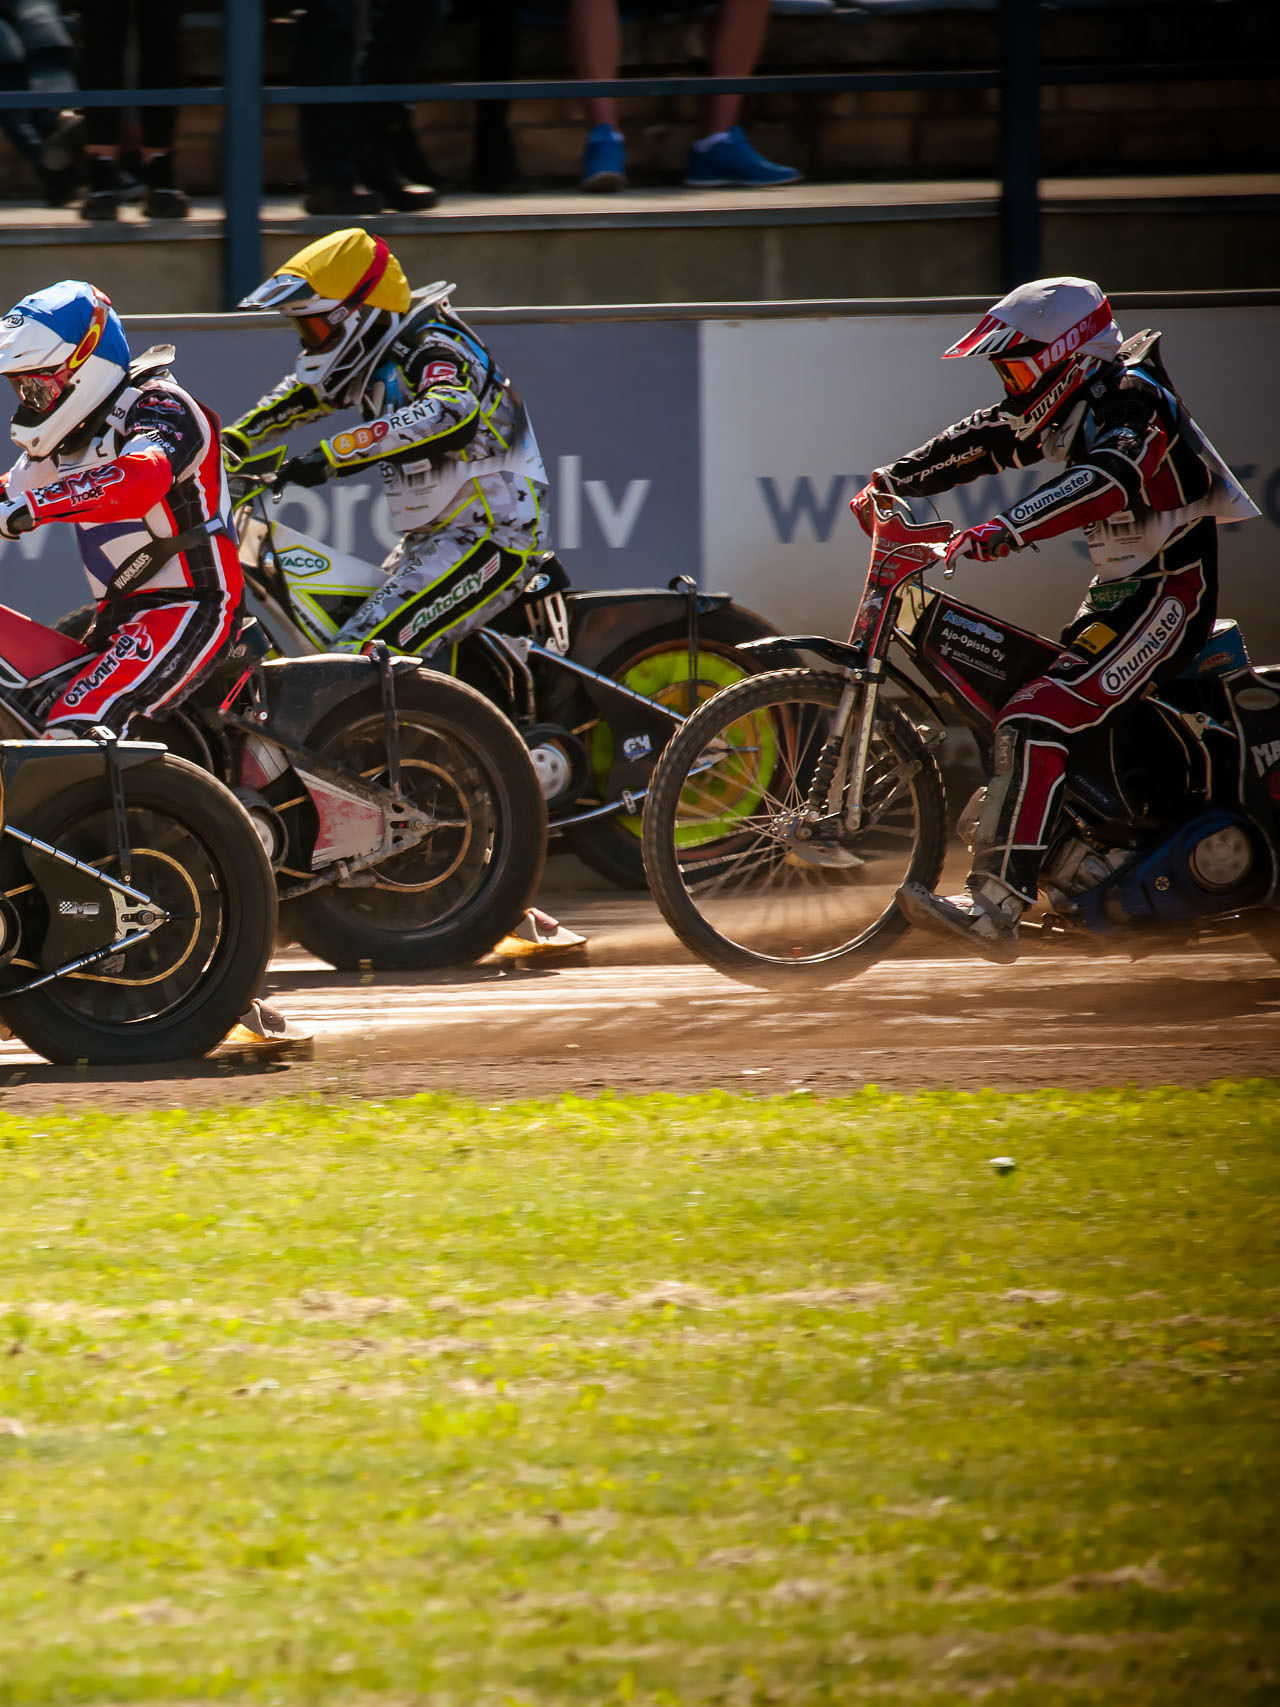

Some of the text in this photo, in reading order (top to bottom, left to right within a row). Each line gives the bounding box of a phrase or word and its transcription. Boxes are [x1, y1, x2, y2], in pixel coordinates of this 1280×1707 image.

[390, 402, 437, 431] RENT
[70, 487, 105, 505] STORE
[114, 552, 150, 590] WARKAUS
[411, 570, 484, 633] AutoCity
